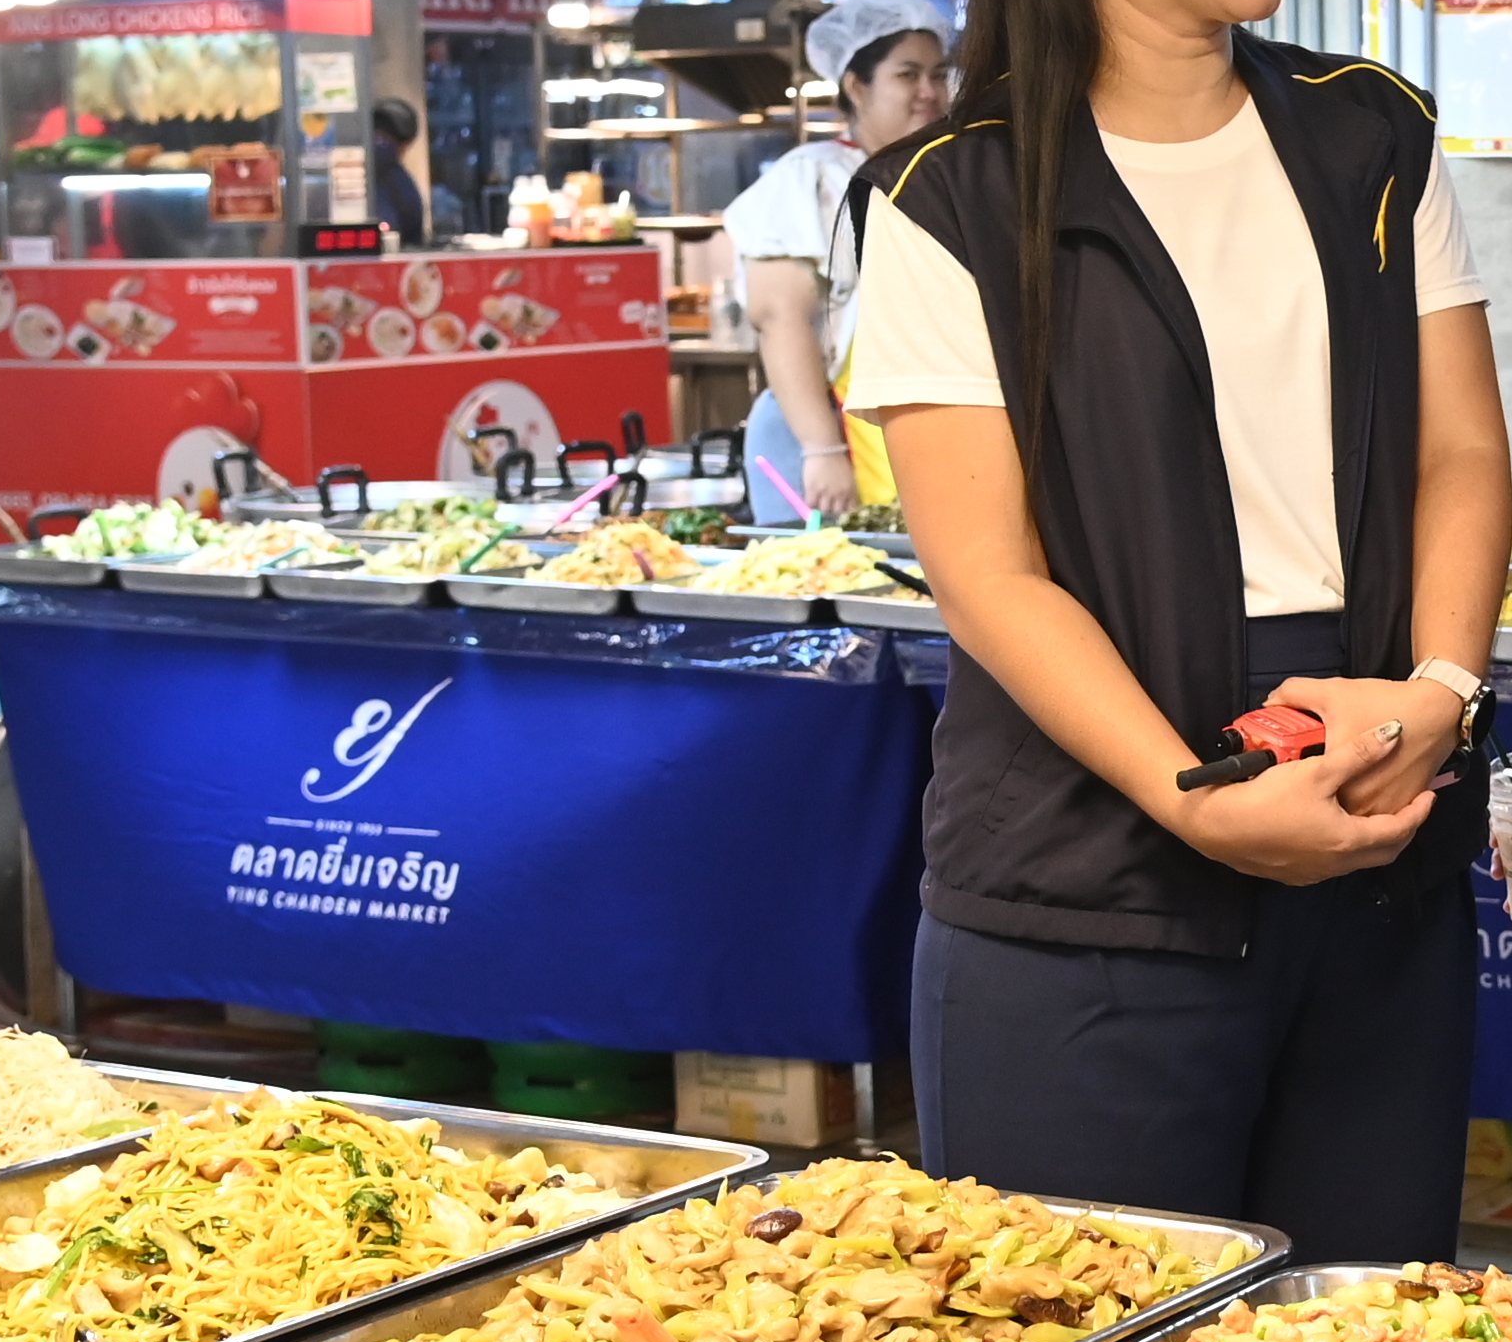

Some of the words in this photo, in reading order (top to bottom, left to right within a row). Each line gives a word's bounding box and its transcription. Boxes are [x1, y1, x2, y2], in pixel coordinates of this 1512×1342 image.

[229, 834, 460, 902] ตลาดยิ่งเจริญ
[225, 884, 270, 908] YING
[272, 888, 363, 918] CHAROEN
[365, 899, 451, 926] MARKET
